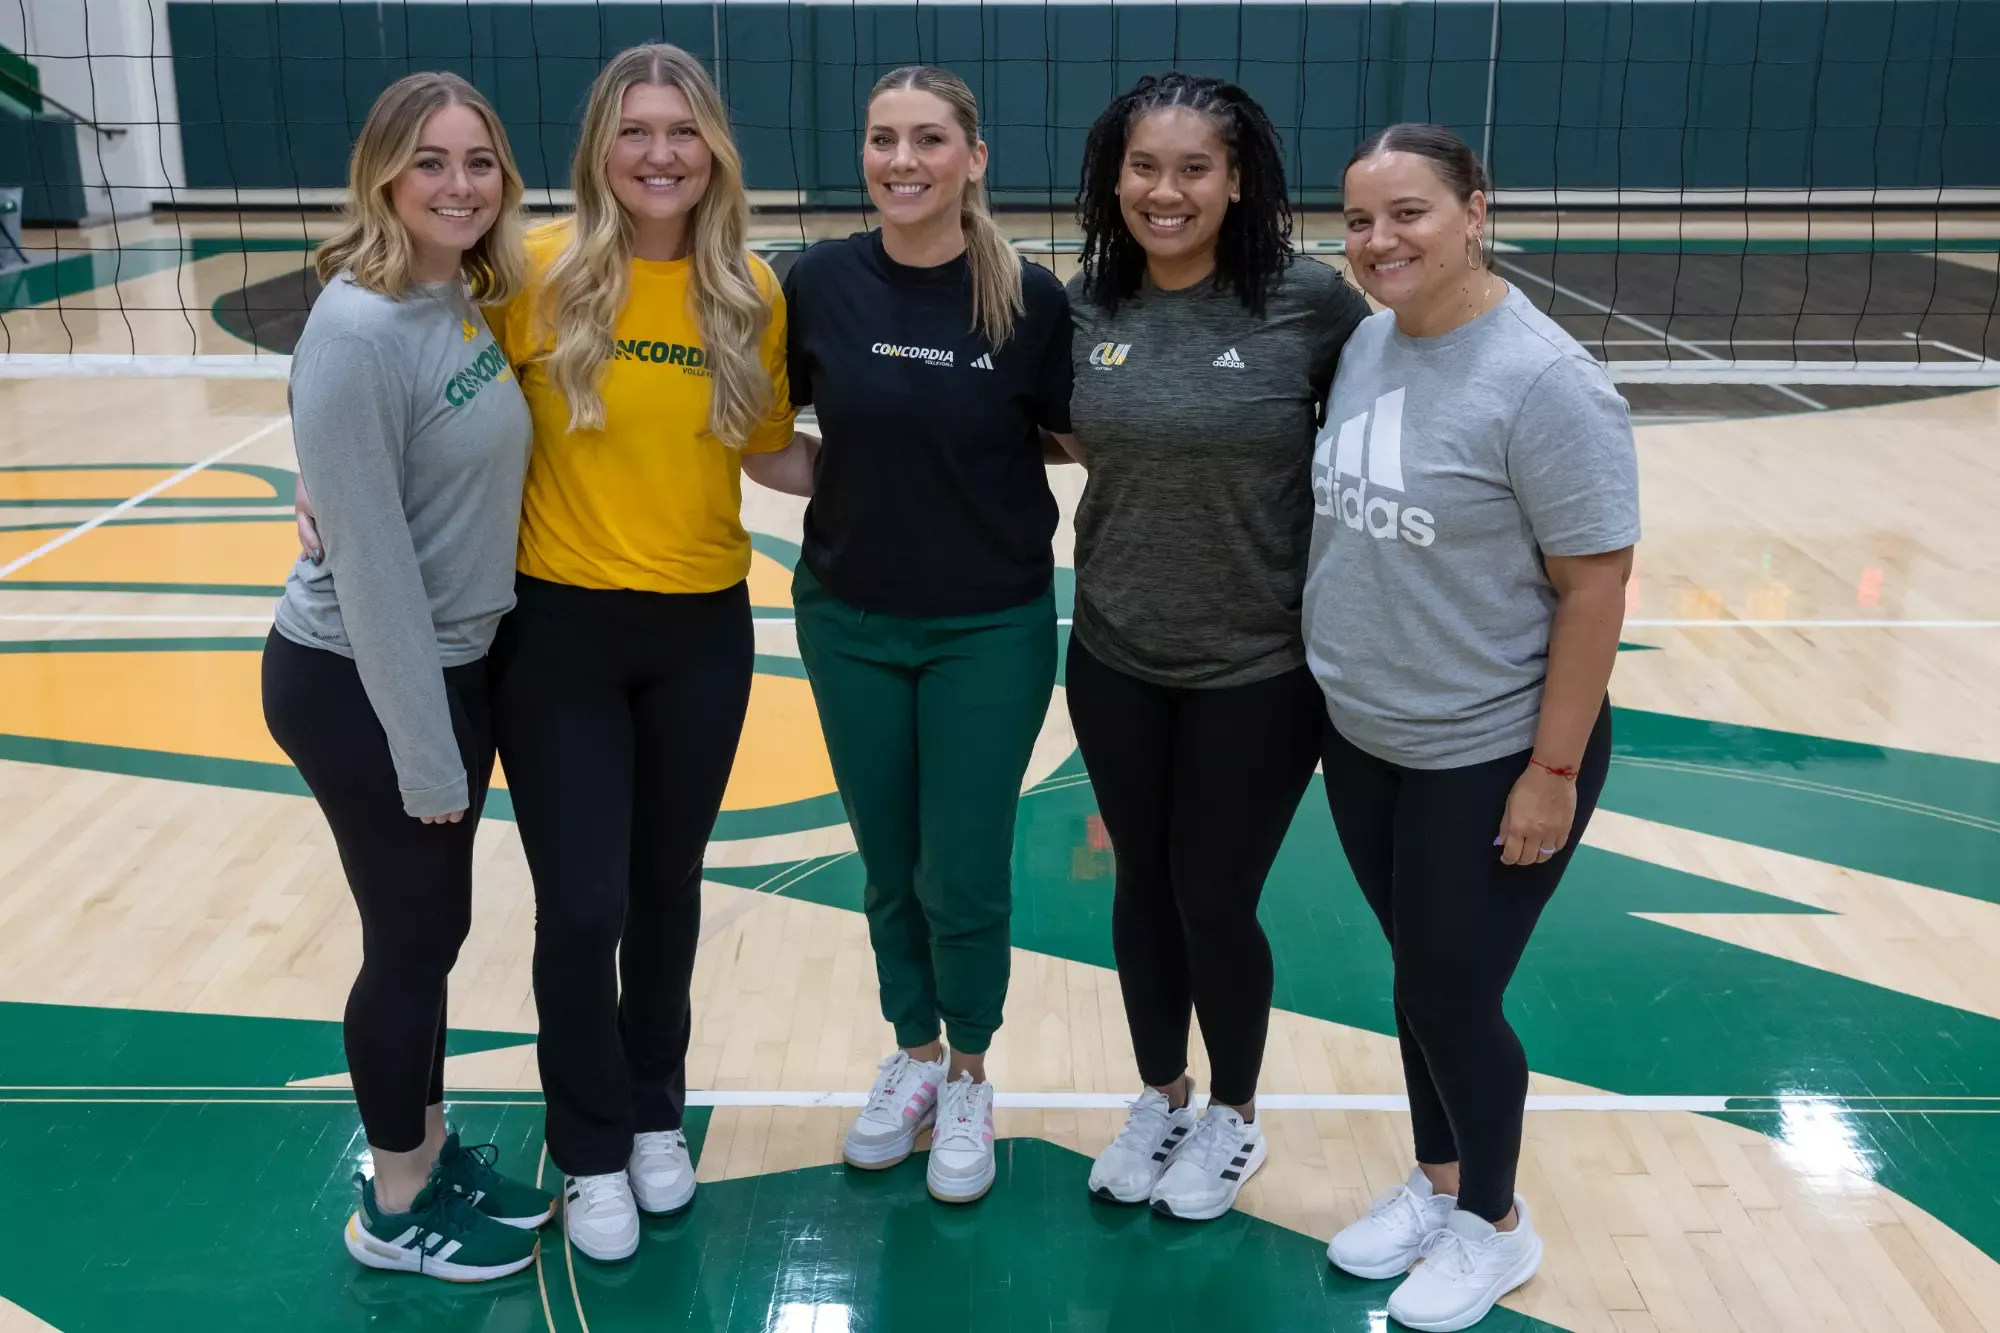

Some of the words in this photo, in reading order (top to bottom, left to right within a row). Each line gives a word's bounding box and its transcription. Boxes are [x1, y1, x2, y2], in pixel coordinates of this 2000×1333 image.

[871, 342, 954, 363] CONCORDIA
[1212, 359, 1245, 369] adidas
[682, 367, 713, 379] VOLLEY
[1312, 466, 1436, 547] didas
